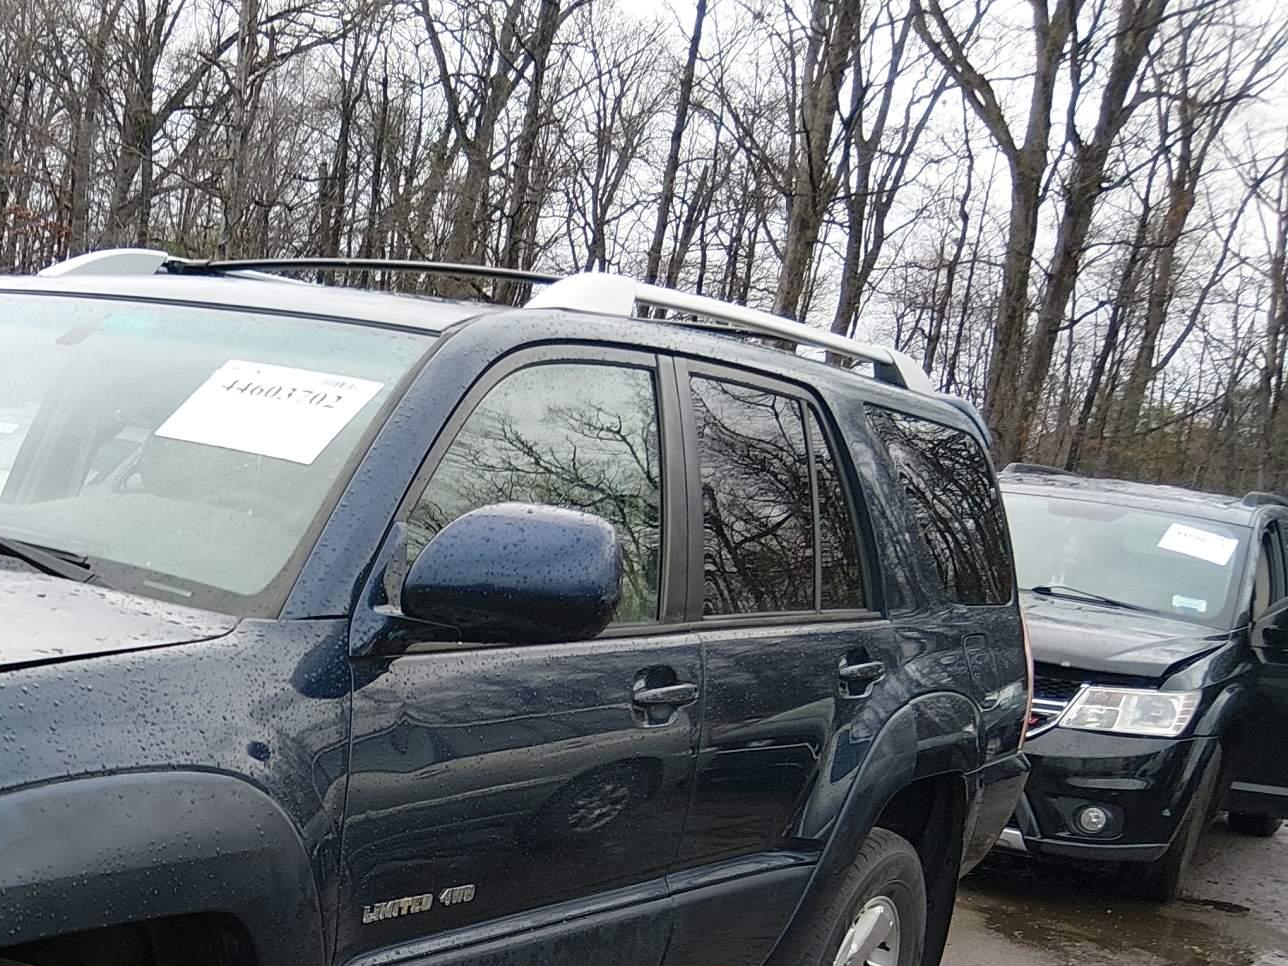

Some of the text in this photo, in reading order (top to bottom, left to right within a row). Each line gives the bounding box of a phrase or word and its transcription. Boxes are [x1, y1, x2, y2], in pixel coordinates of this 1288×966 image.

[221, 379, 344, 409] 44603702
[362, 884, 476, 924] LIMITED 4WD
